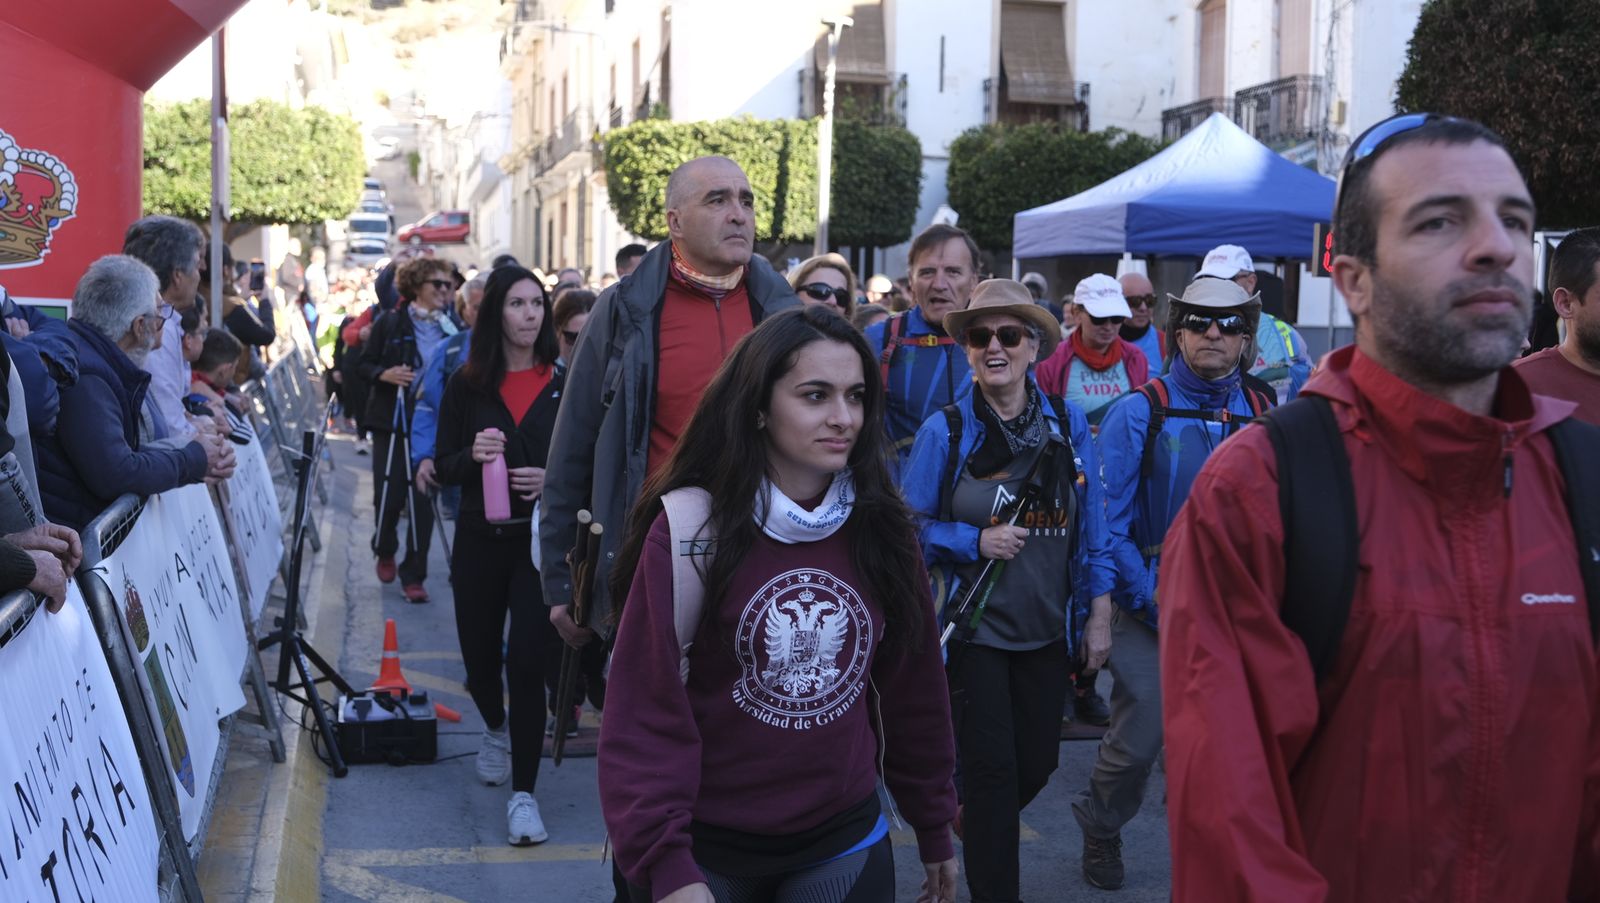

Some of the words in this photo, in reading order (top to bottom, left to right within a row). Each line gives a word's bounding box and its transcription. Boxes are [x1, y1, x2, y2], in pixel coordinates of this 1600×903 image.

[1081, 367, 1121, 382] PURA
[1082, 383, 1122, 397] VIDA
[777, 701, 809, 710] 1531
[794, 717, 811, 730] de
[815, 681, 865, 726] Granada
